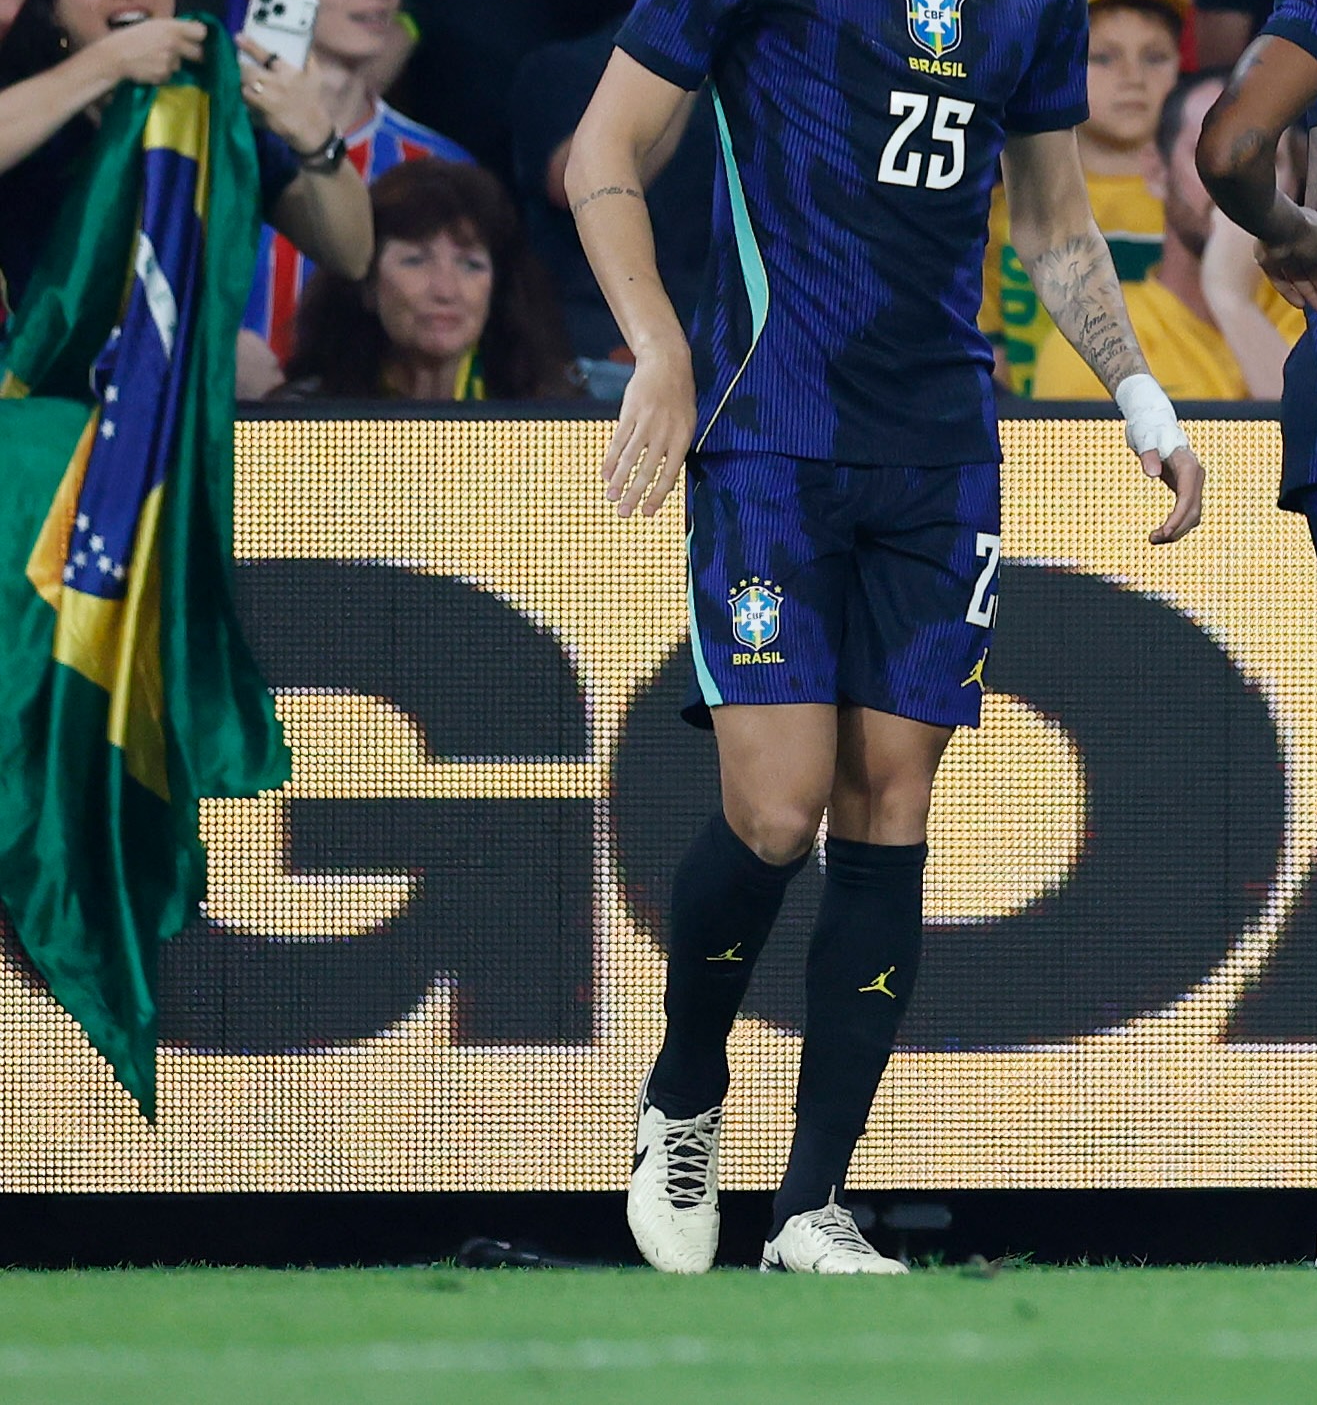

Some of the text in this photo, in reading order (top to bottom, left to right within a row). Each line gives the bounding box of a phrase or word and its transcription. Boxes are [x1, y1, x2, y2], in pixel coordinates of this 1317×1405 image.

[923, 9, 945, 21] CBF
[908, 56, 968, 78] BRASIL
[877, 89, 976, 191] 25
[965, 532, 1000, 629] 2
[732, 651, 785, 665] BRASIL
